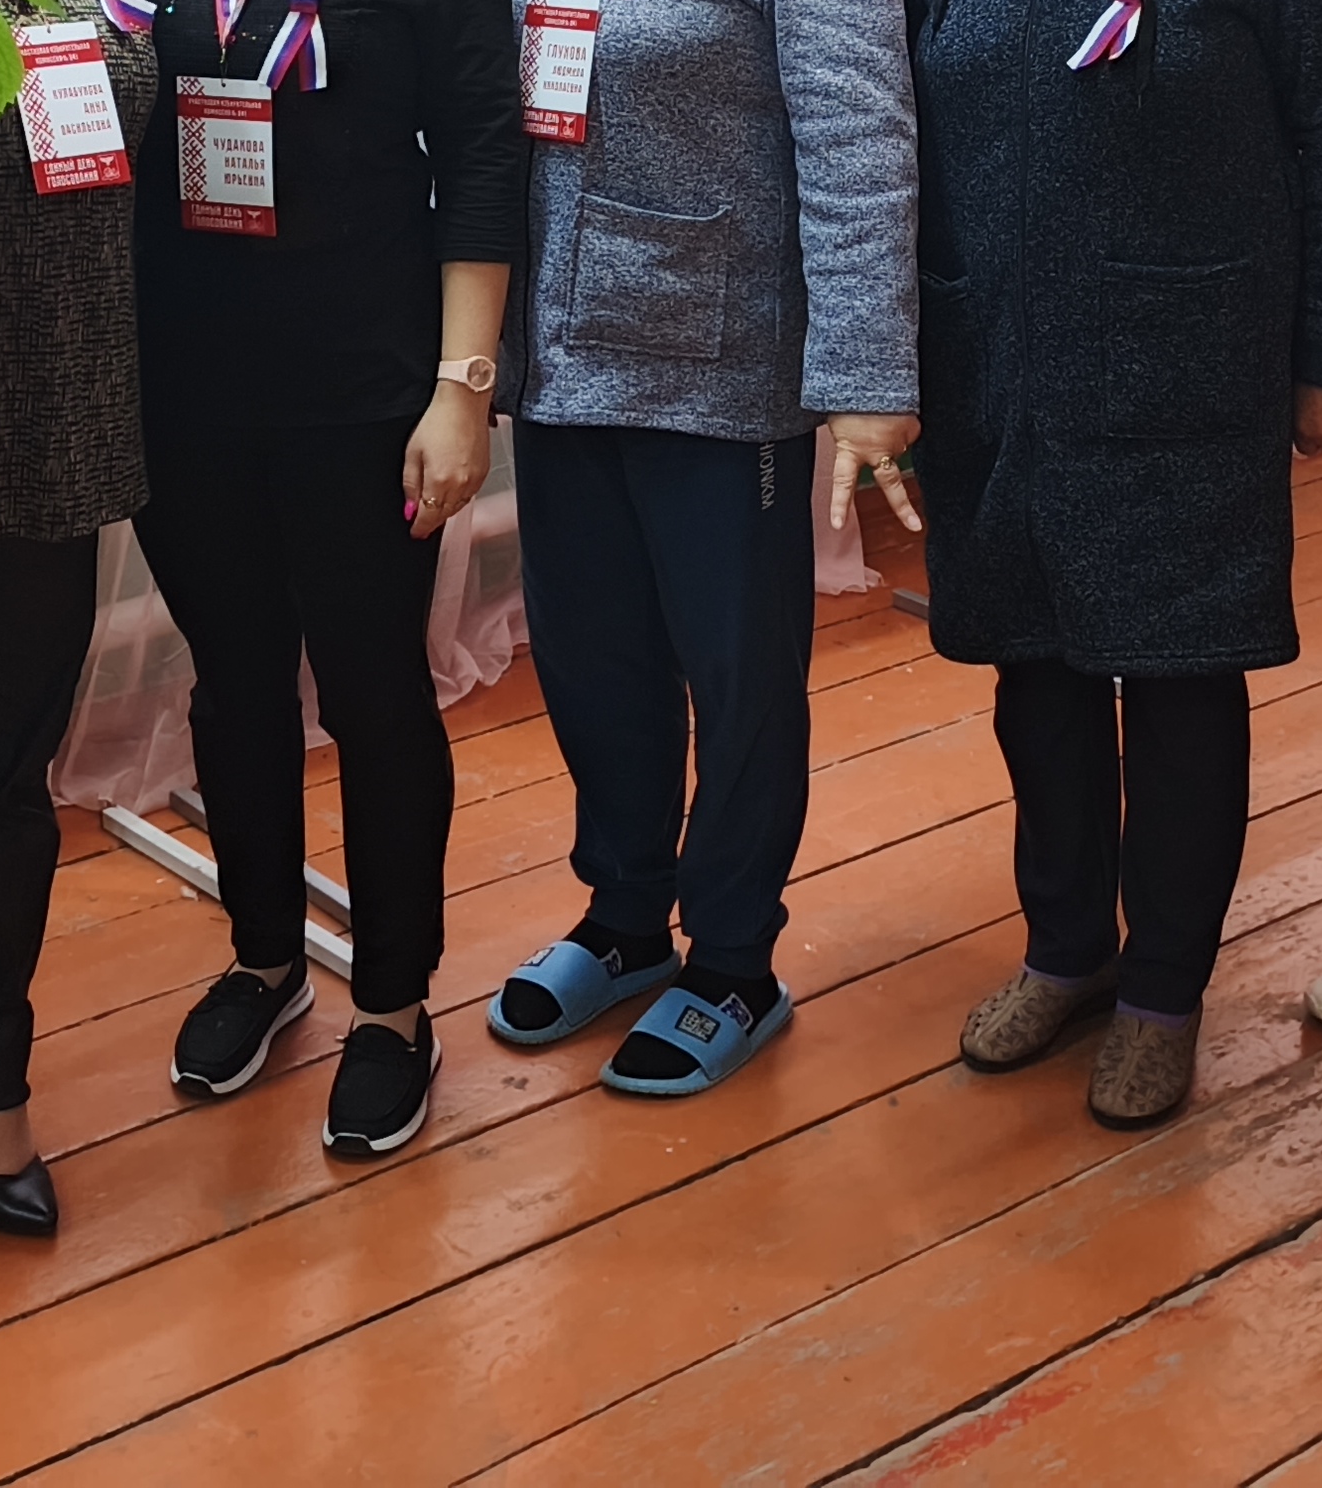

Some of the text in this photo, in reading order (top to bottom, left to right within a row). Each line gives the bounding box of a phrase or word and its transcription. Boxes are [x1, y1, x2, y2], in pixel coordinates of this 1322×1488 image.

[547, 44, 586, 61] ГЛУХОВА
[83, 100, 108, 114] АННА
[61, 119, 111, 136] ВАСИЛЬЕВНА
[213, 138, 264, 153] ЧУДАКОВА
[224, 157, 265, 171] НАТАЛЬЯ
[224, 173, 265, 188] ЮРЬЕВНА
